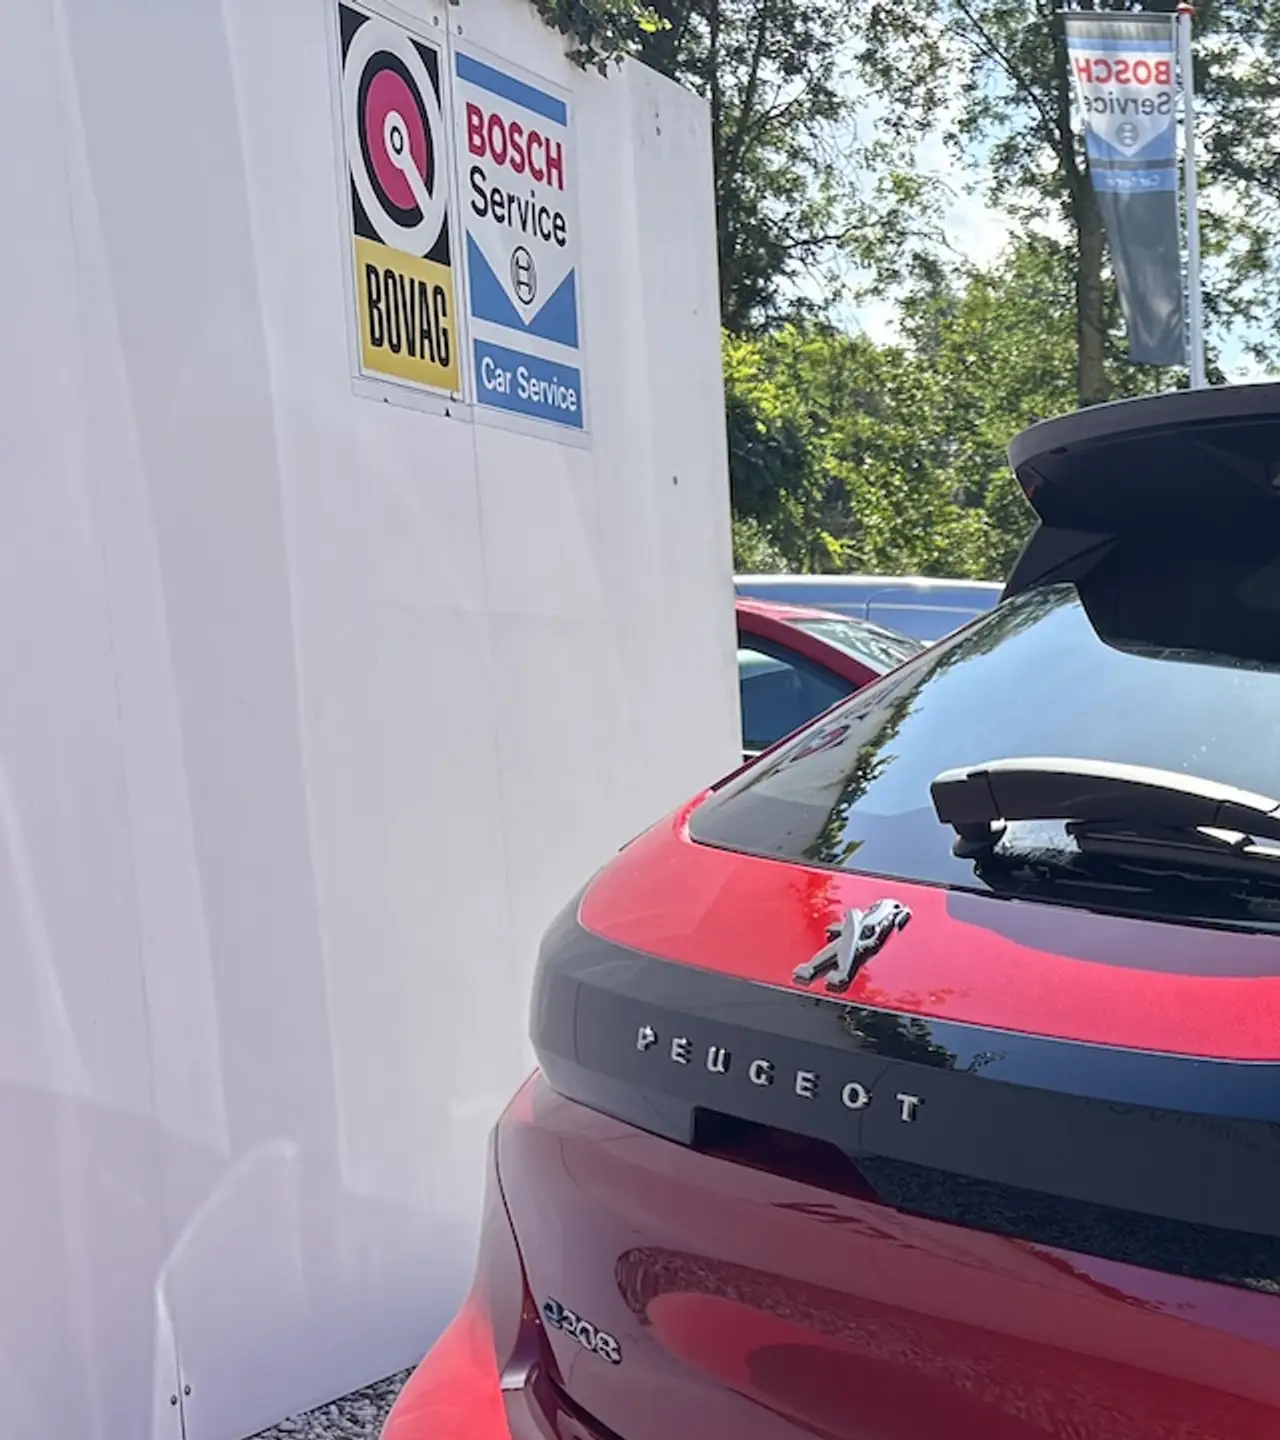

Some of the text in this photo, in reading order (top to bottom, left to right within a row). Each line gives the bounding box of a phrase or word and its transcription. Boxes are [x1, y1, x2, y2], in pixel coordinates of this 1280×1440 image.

[466, 102, 565, 190] BOSCH
[469, 166, 567, 248] Service
[365, 263, 450, 368] BOVAG
[481, 355, 577, 412] Car Service
[636, 1025, 924, 1123] PEUGEOT
